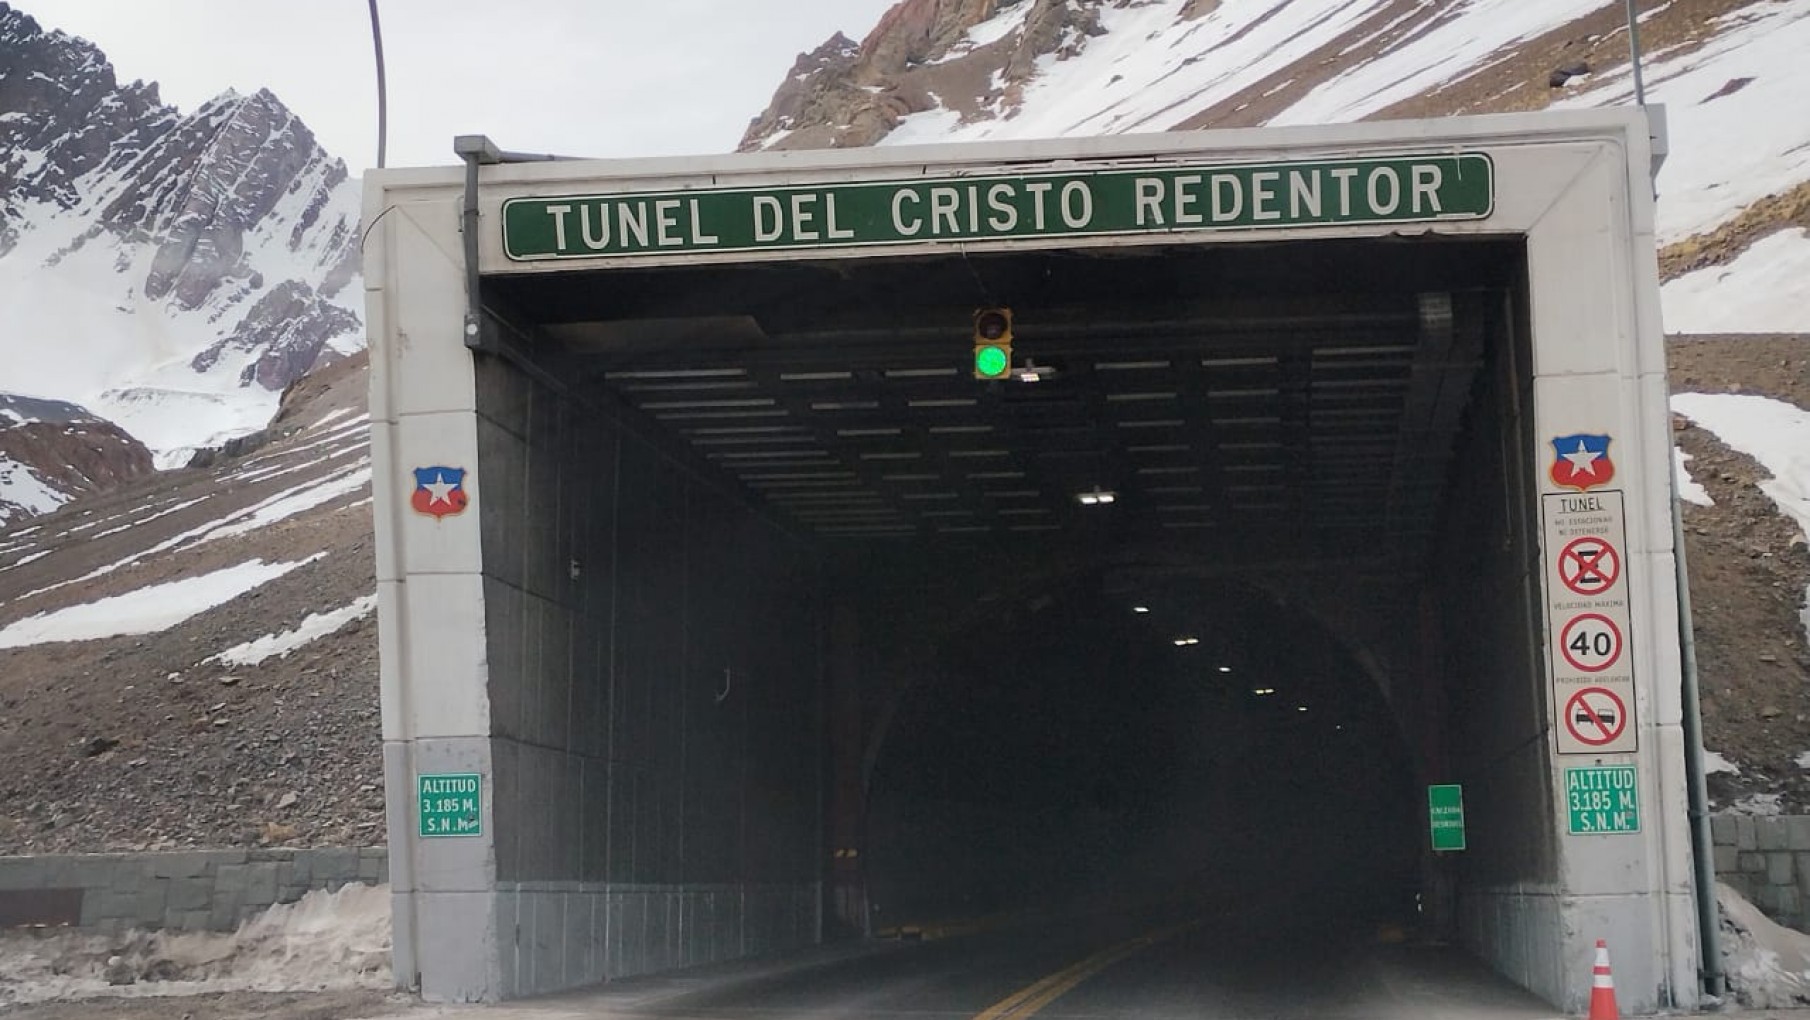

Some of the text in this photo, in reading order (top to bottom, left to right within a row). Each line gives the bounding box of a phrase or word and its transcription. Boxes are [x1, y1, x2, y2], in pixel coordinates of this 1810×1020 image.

[546, 164, 1443, 251] TUNEL DEL CRISTO REDENTOR
[1560, 496, 1604, 512] TUNEL
[1570, 631, 1611, 656] 40
[422, 779, 476, 793] ALTITUD
[1570, 770, 1634, 790] ALTITUD
[423, 798, 478, 813] 3.185 M.
[1571, 790, 1635, 811] 3.185 M.
[1580, 811, 1630, 831] S.N.M.
